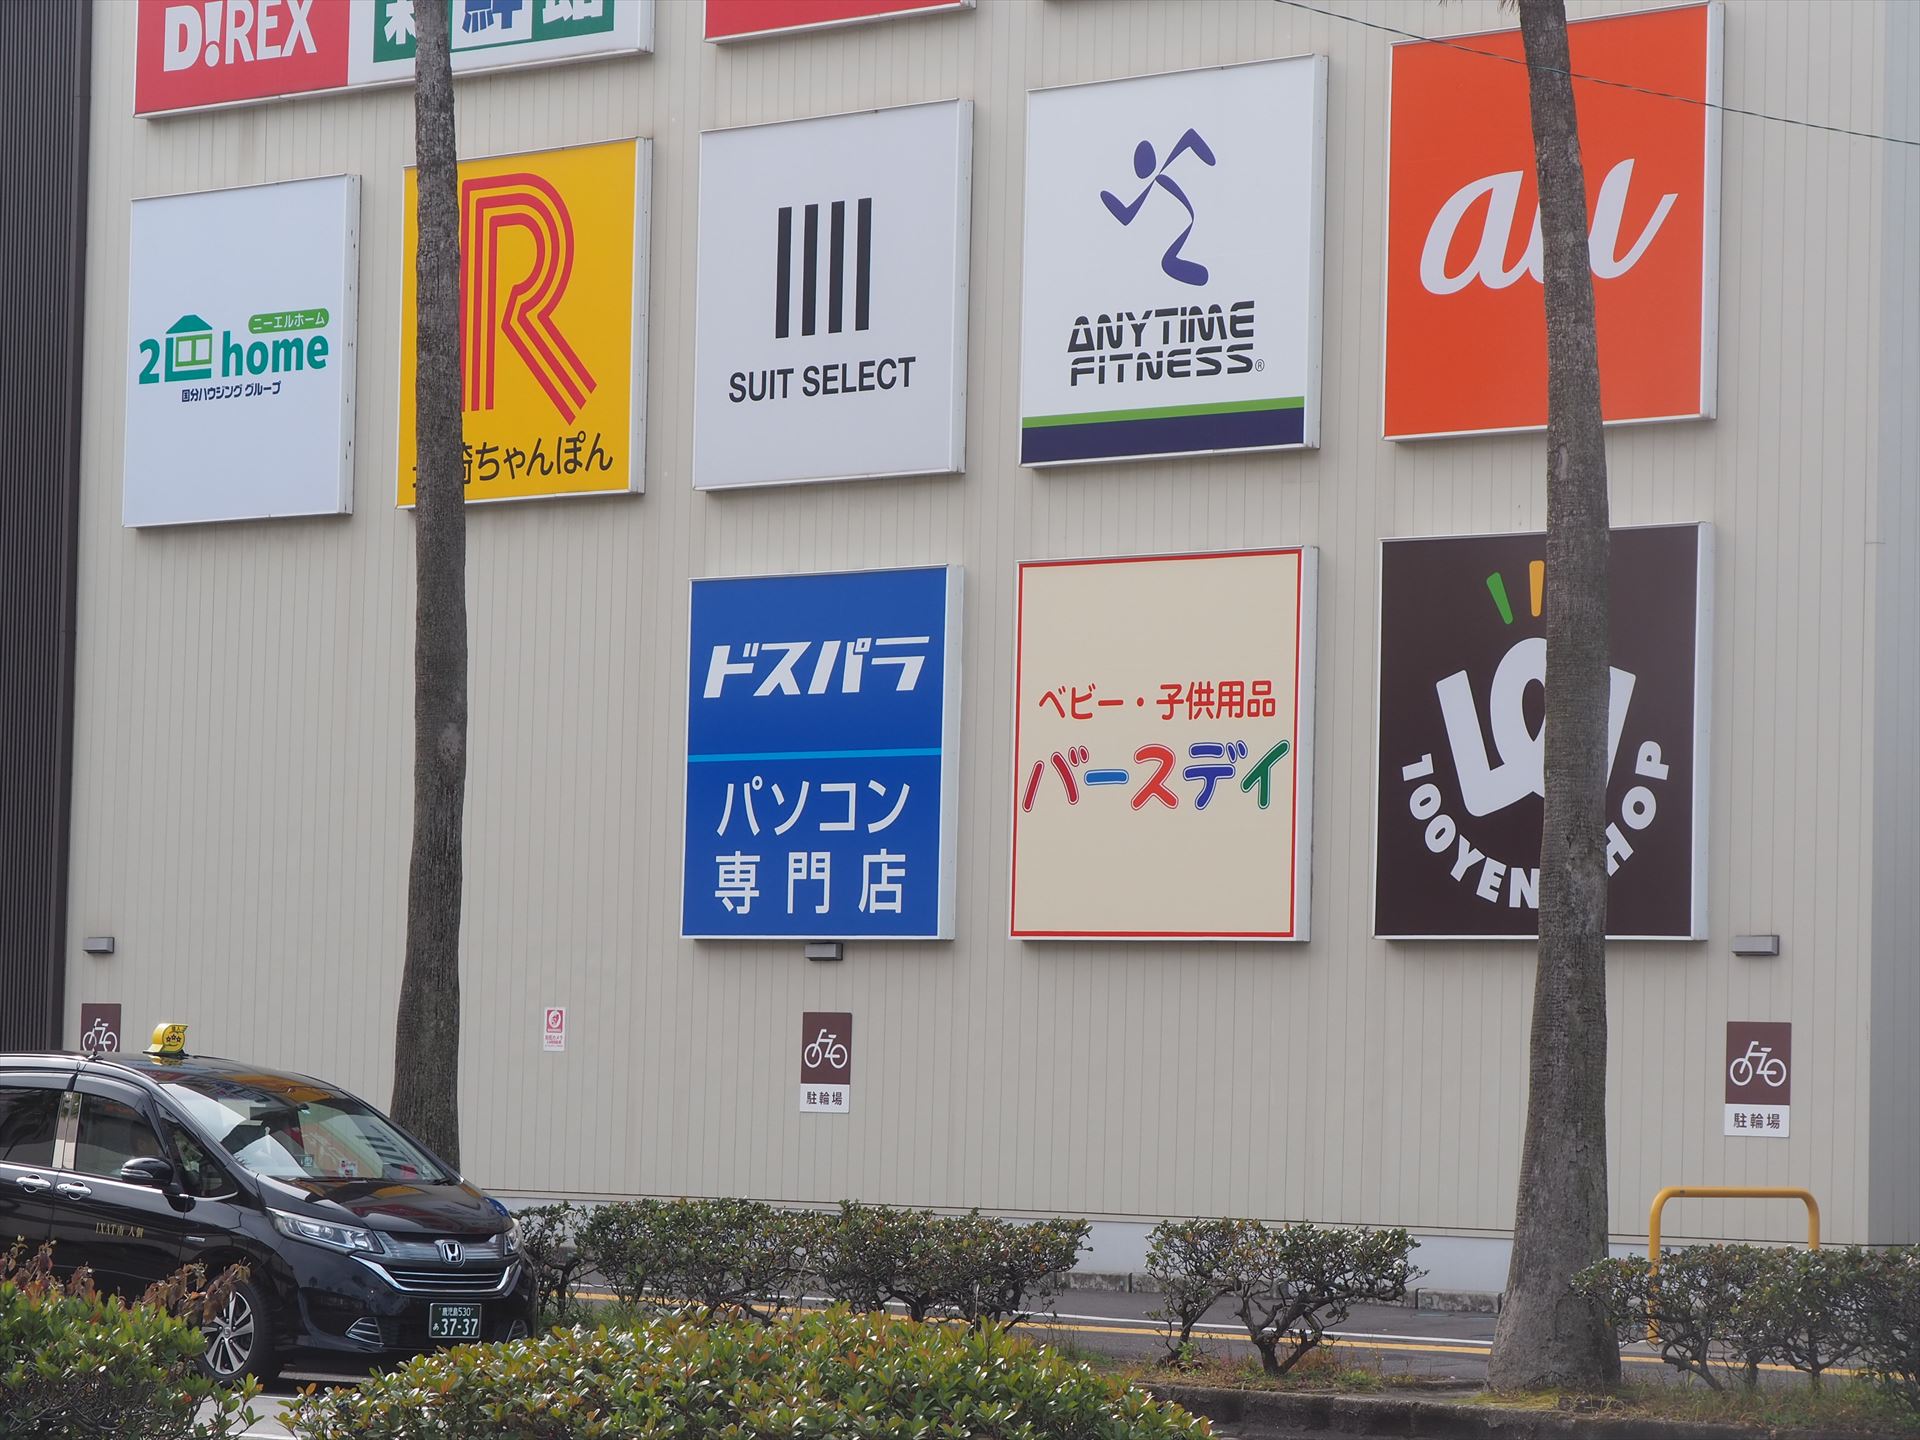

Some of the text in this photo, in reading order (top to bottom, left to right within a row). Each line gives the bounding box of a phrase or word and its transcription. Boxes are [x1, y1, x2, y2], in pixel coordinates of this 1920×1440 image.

[1420, 158, 1679, 295] au
[252, 312, 325, 331] ニーエルホーム
[1067, 300, 1255, 353] ANYTIME
[221, 330, 329, 378] home
[1070, 343, 1254, 387] FITNESS
[181, 380, 282, 402] 国分ハウジング グループ
[728, 356, 916, 403] SUIT SELECT
[412, 430, 614, 488] ちゃんぽん
[703, 636, 930, 699] ドスパラ
[1039, 680, 1276, 720] ベビー・子供用品
[716, 775, 910, 837] パソコン
[1605, 740, 1669, 877] HOP
[714, 848, 907, 915] 専門店
[806, 1091, 843, 1105] 駐輪場
[1733, 1112, 1780, 1129] 駐輪場
[440, 1318, 478, 1336] 37-37
